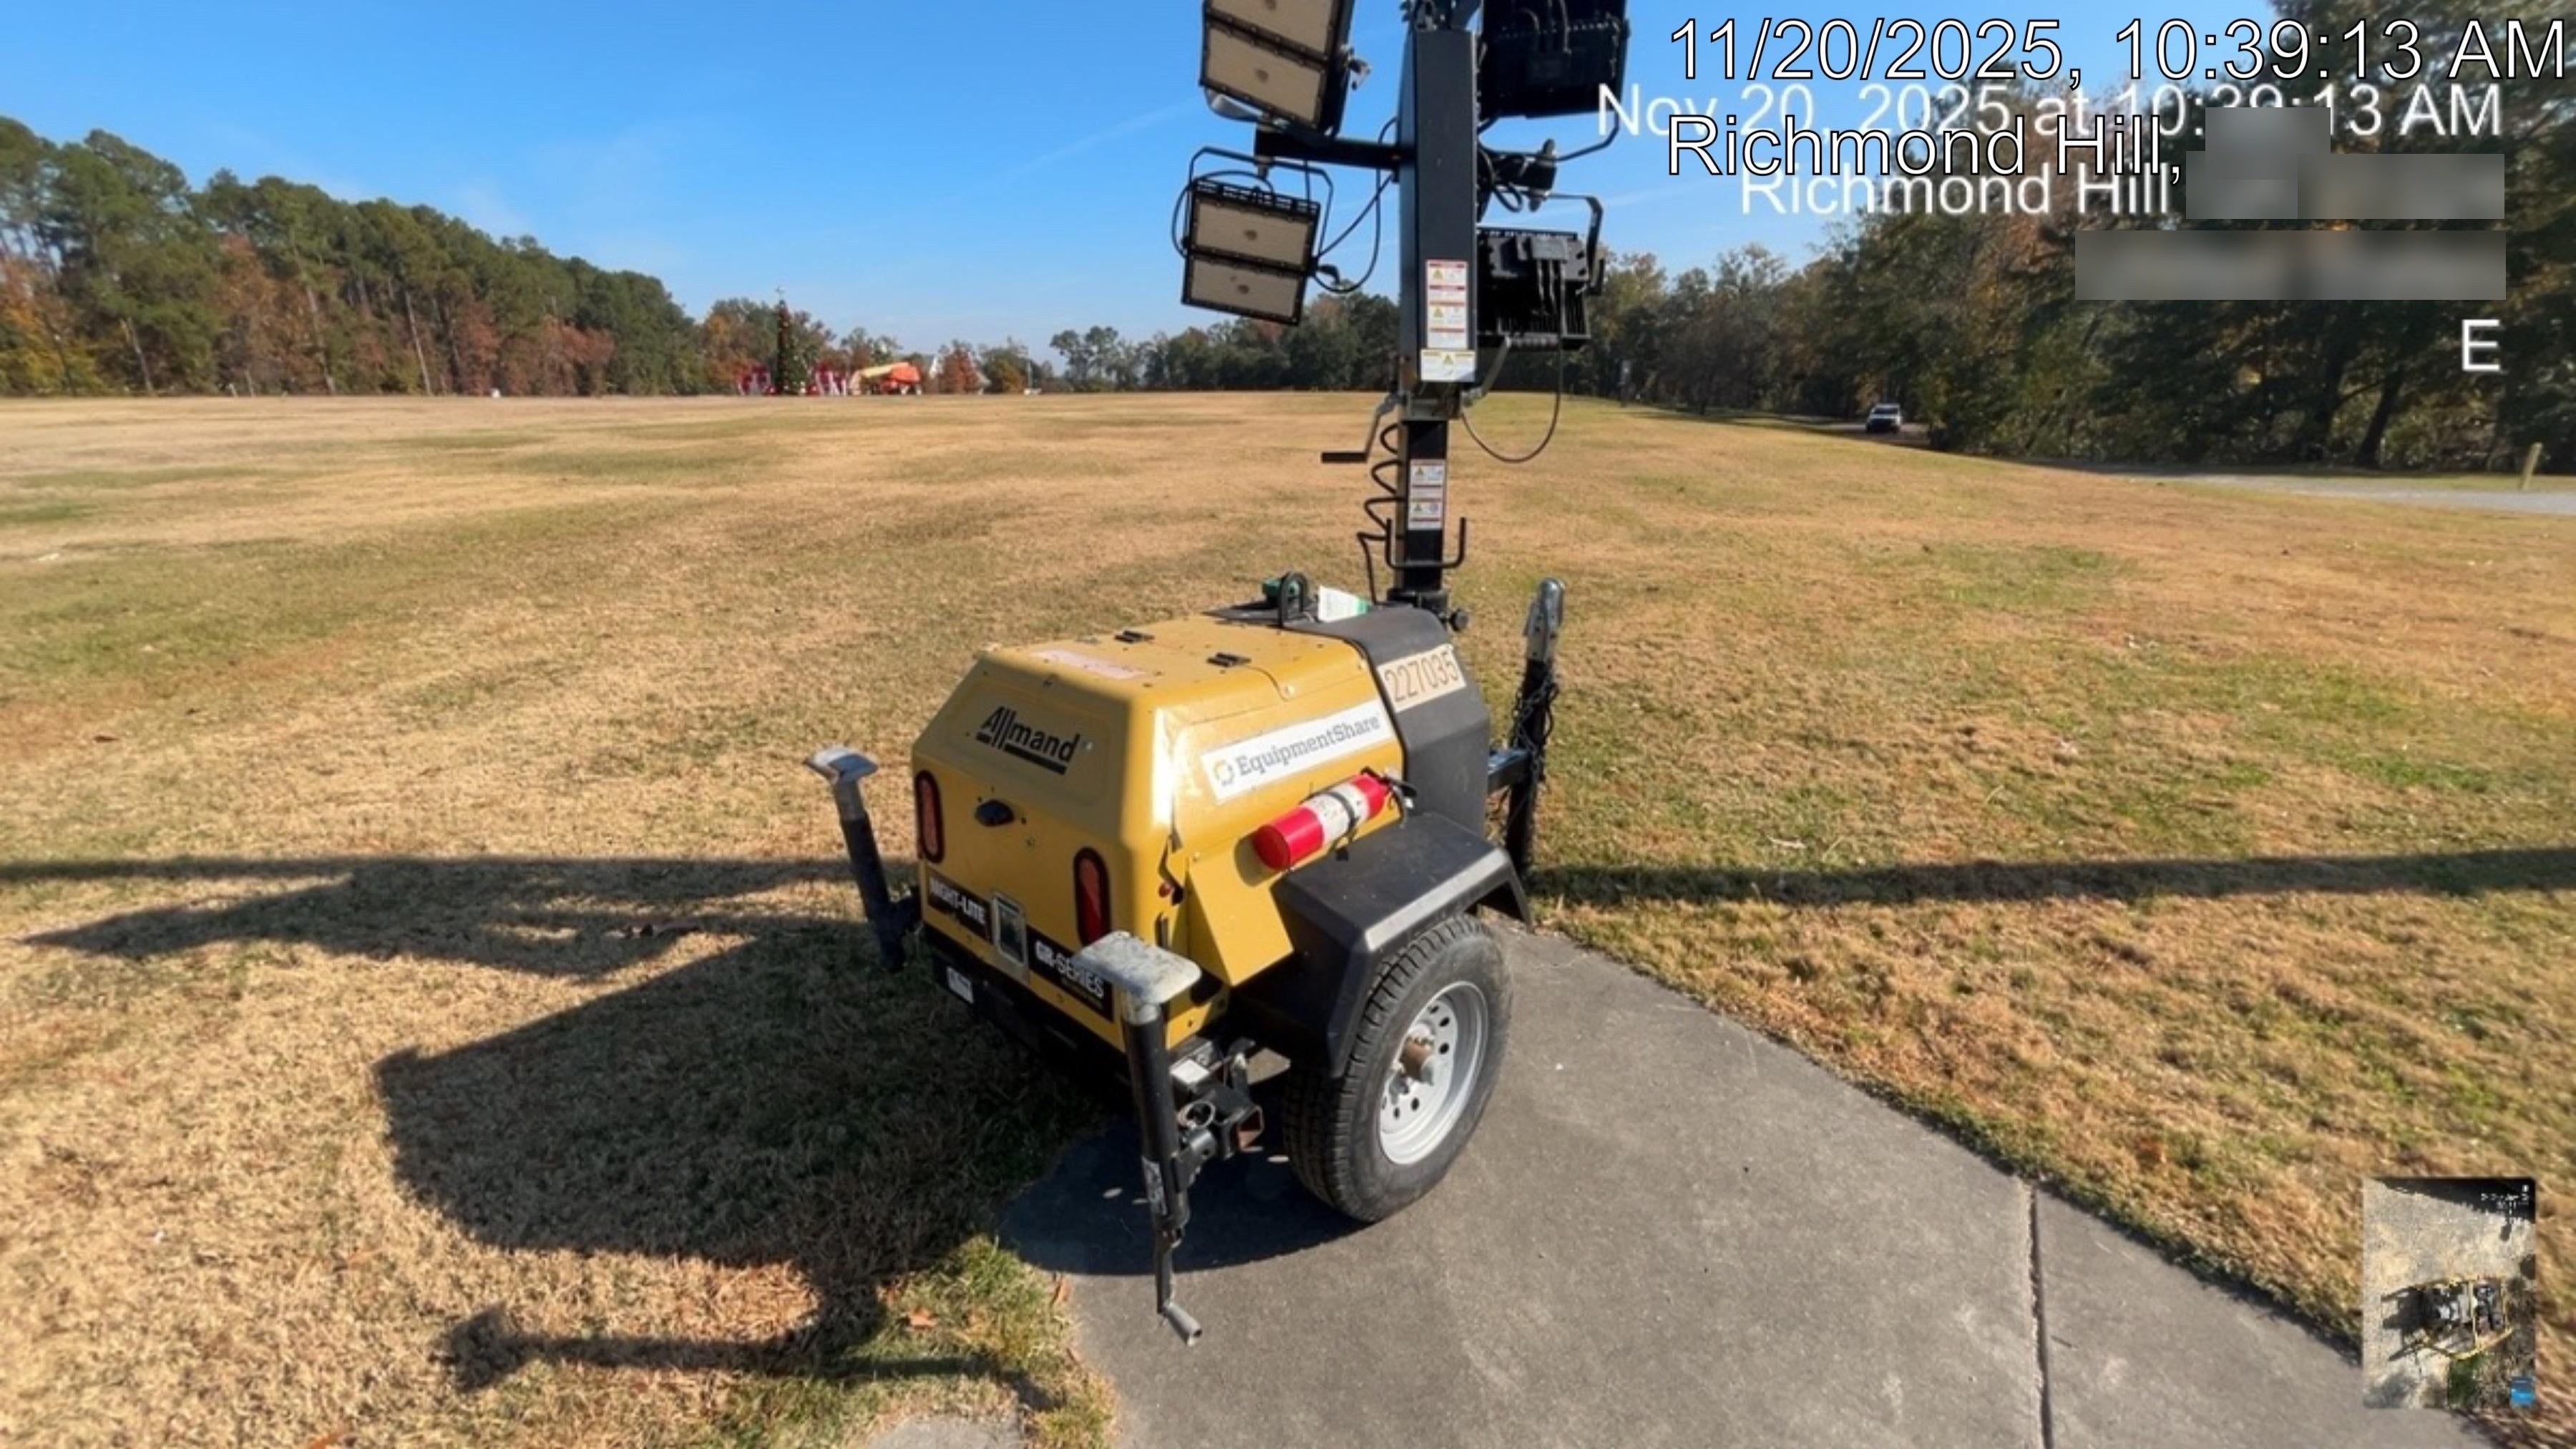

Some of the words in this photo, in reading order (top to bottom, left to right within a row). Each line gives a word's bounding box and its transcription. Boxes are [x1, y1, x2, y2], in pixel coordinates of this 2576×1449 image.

[1385, 650, 1458, 702] 227035
[977, 706, 1081, 764] Allmand
[1234, 716, 1381, 776] EquipmentShare
